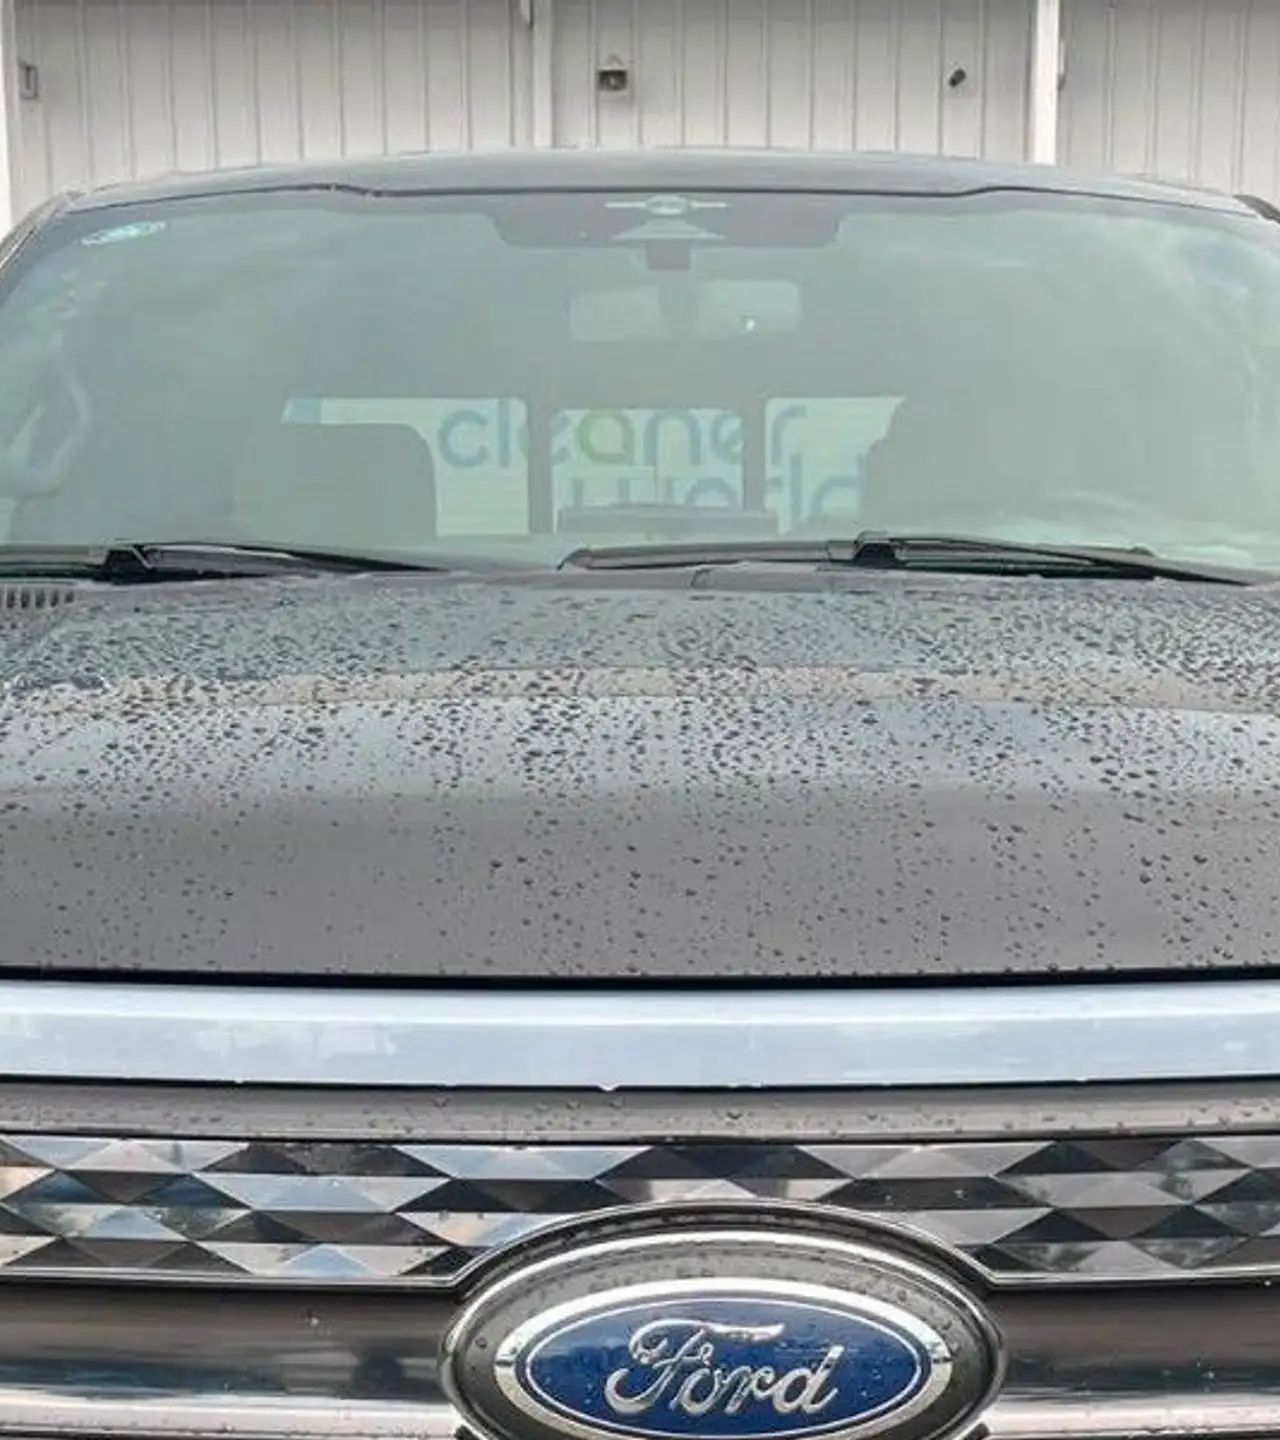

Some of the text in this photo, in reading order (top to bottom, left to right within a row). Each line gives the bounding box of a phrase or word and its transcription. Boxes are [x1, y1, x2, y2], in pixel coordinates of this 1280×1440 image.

[437, 398, 809, 469] cleaner
[563, 452, 866, 524] wold
[603, 1318, 845, 1415] Ford
